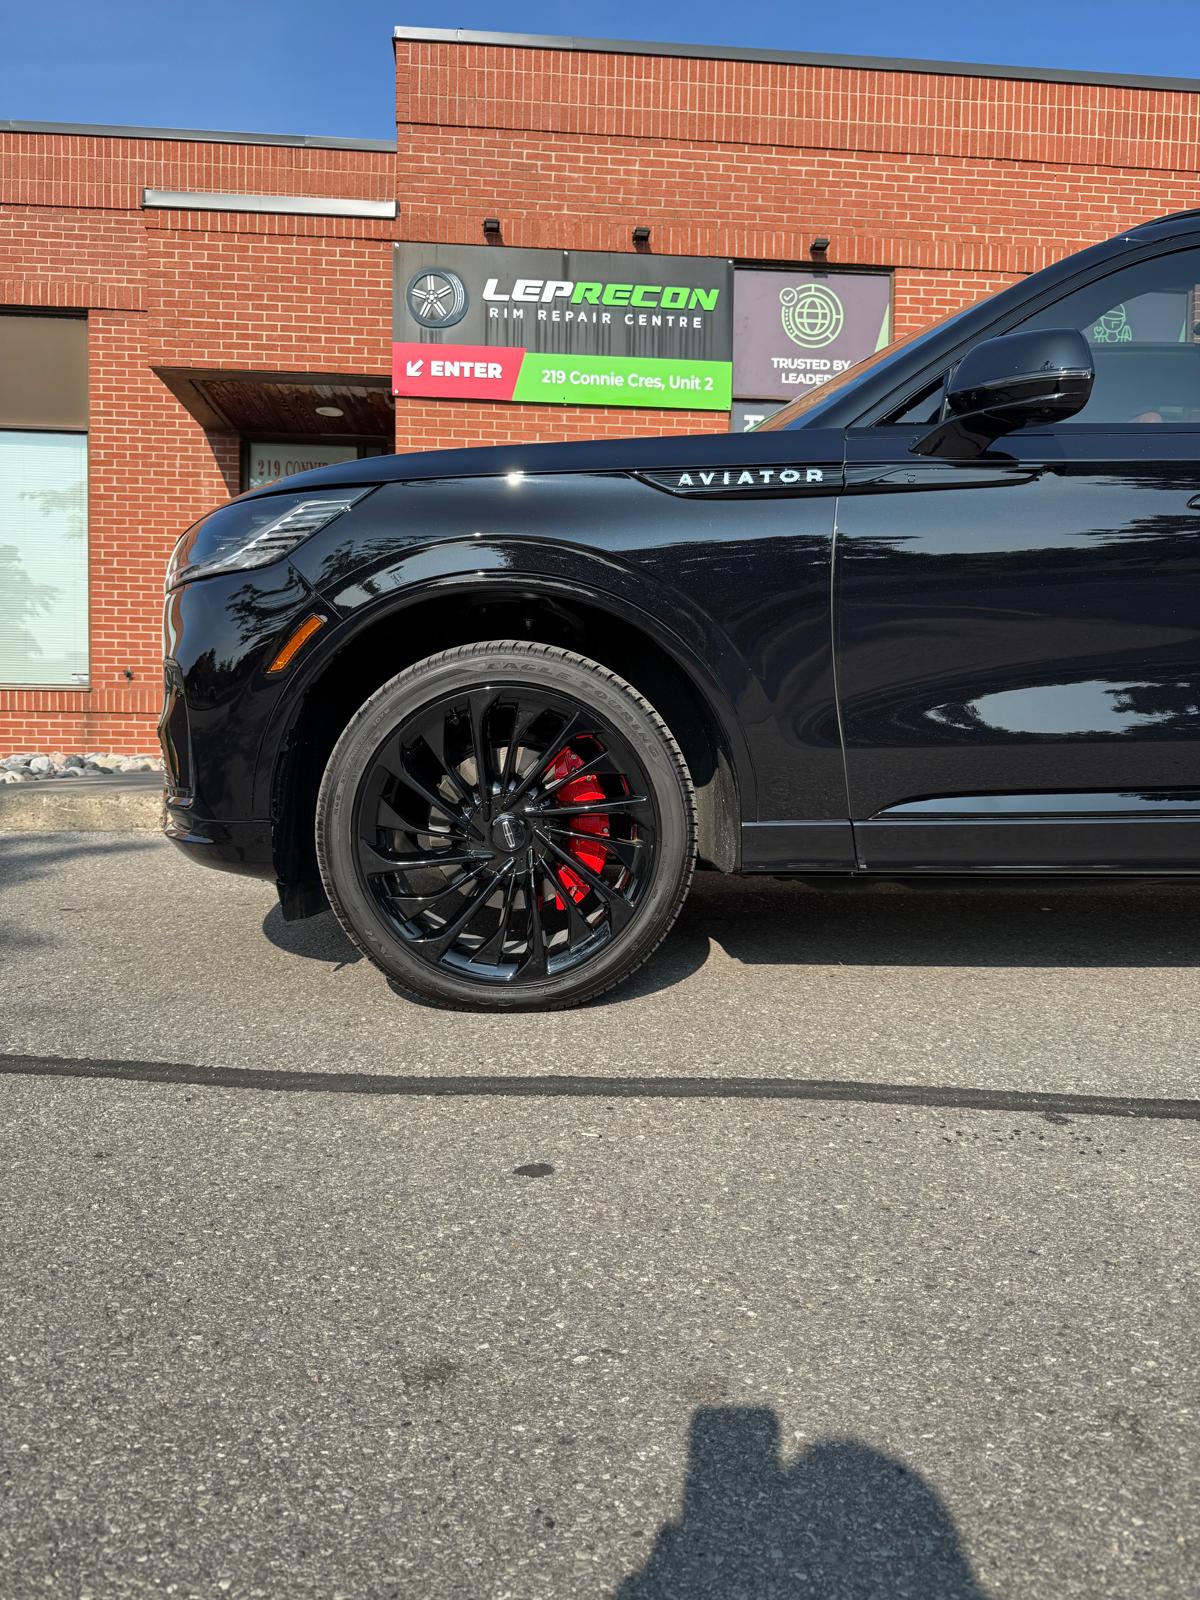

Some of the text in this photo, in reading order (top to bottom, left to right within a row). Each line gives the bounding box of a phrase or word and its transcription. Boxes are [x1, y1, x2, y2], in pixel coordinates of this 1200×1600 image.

[482, 278, 720, 311] LEPRECON
[489, 307, 702, 328] RIM REPAIR CENTRE
[430, 360, 503, 379] ENTER
[771, 357, 851, 371] TRUSTED BY
[541, 370, 714, 390] 219 Connie Cres, Unit 2
[258, 460, 281, 476] 219
[677, 468, 824, 487] AVIATOR
